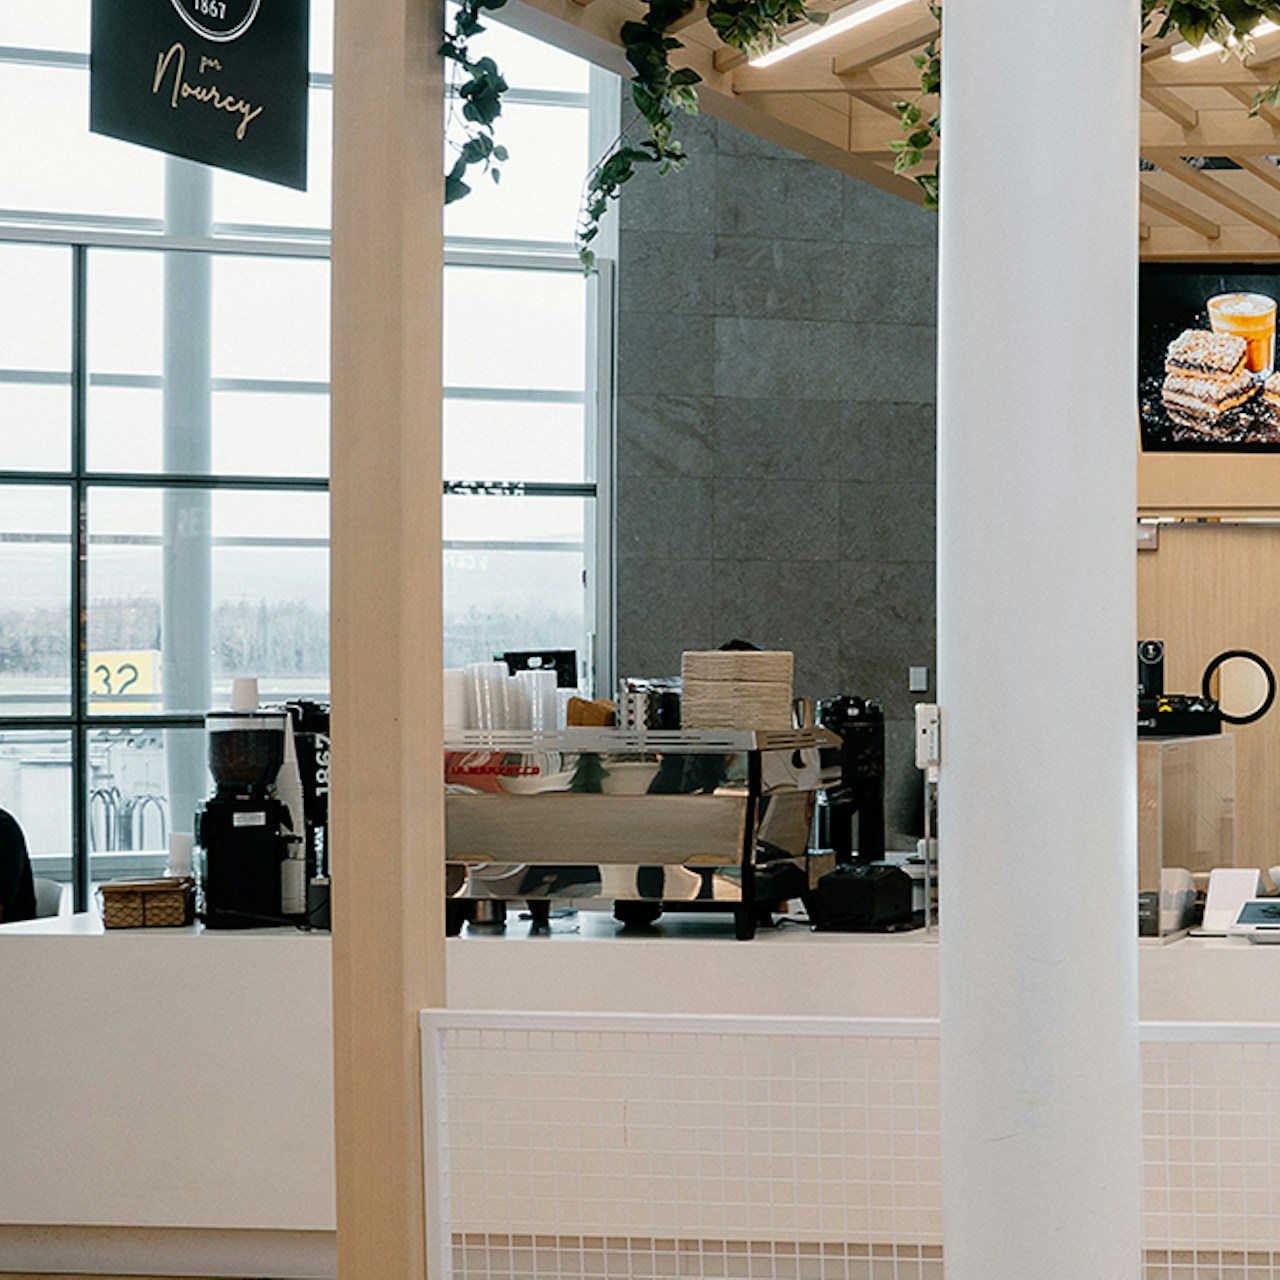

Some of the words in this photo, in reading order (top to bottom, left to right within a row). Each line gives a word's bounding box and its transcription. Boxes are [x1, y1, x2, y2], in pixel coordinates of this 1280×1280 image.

[199, 55, 222, 74] par
[152, 42, 263, 141] Nourcy
[92, 663, 139, 695] 32
